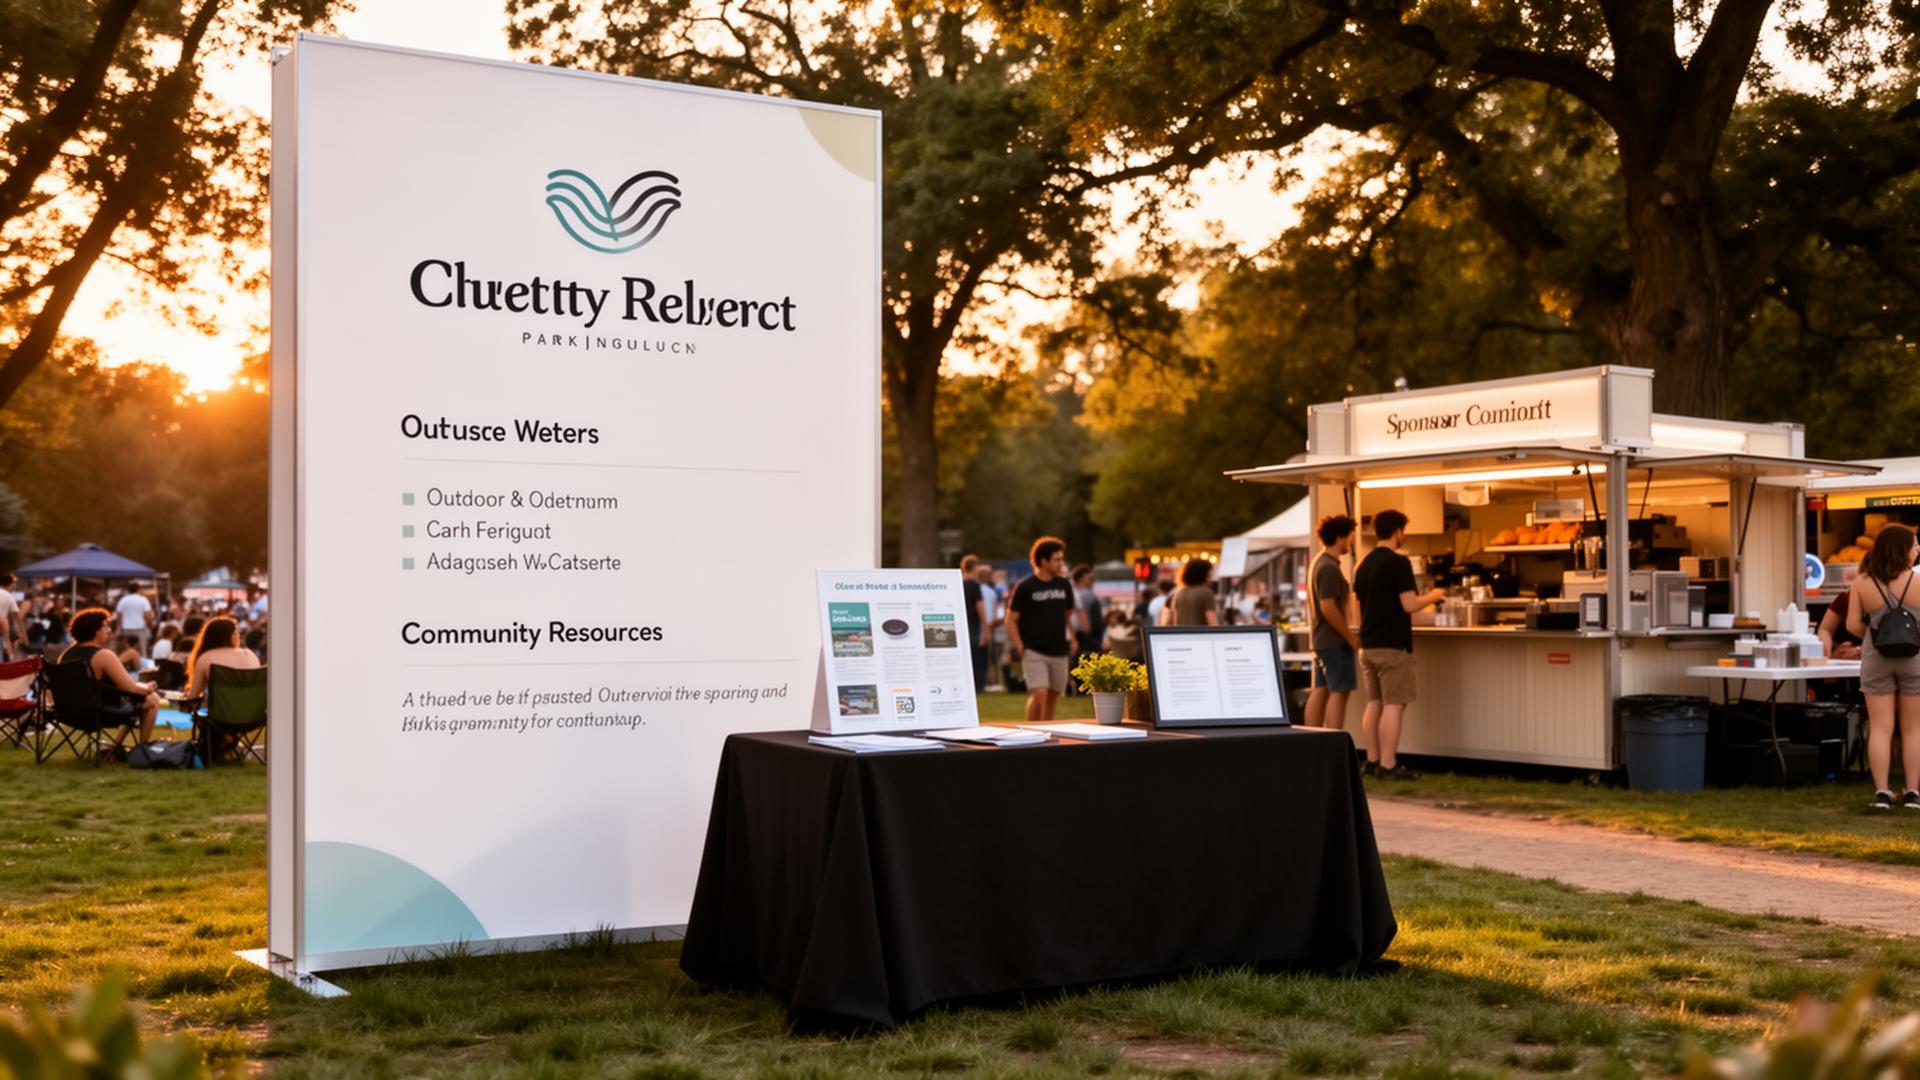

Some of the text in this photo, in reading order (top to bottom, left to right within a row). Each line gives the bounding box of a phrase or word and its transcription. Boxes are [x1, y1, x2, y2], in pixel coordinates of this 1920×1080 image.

[514, 419, 600, 445] Weters
[427, 487, 505, 507] Outdoor
[510, 490, 524, 508] &
[427, 519, 471, 538] Carh
[401, 620, 664, 650] Community Resources
[402, 691, 414, 707] A
[761, 682, 788, 699] and
[530, 712, 554, 730] for
